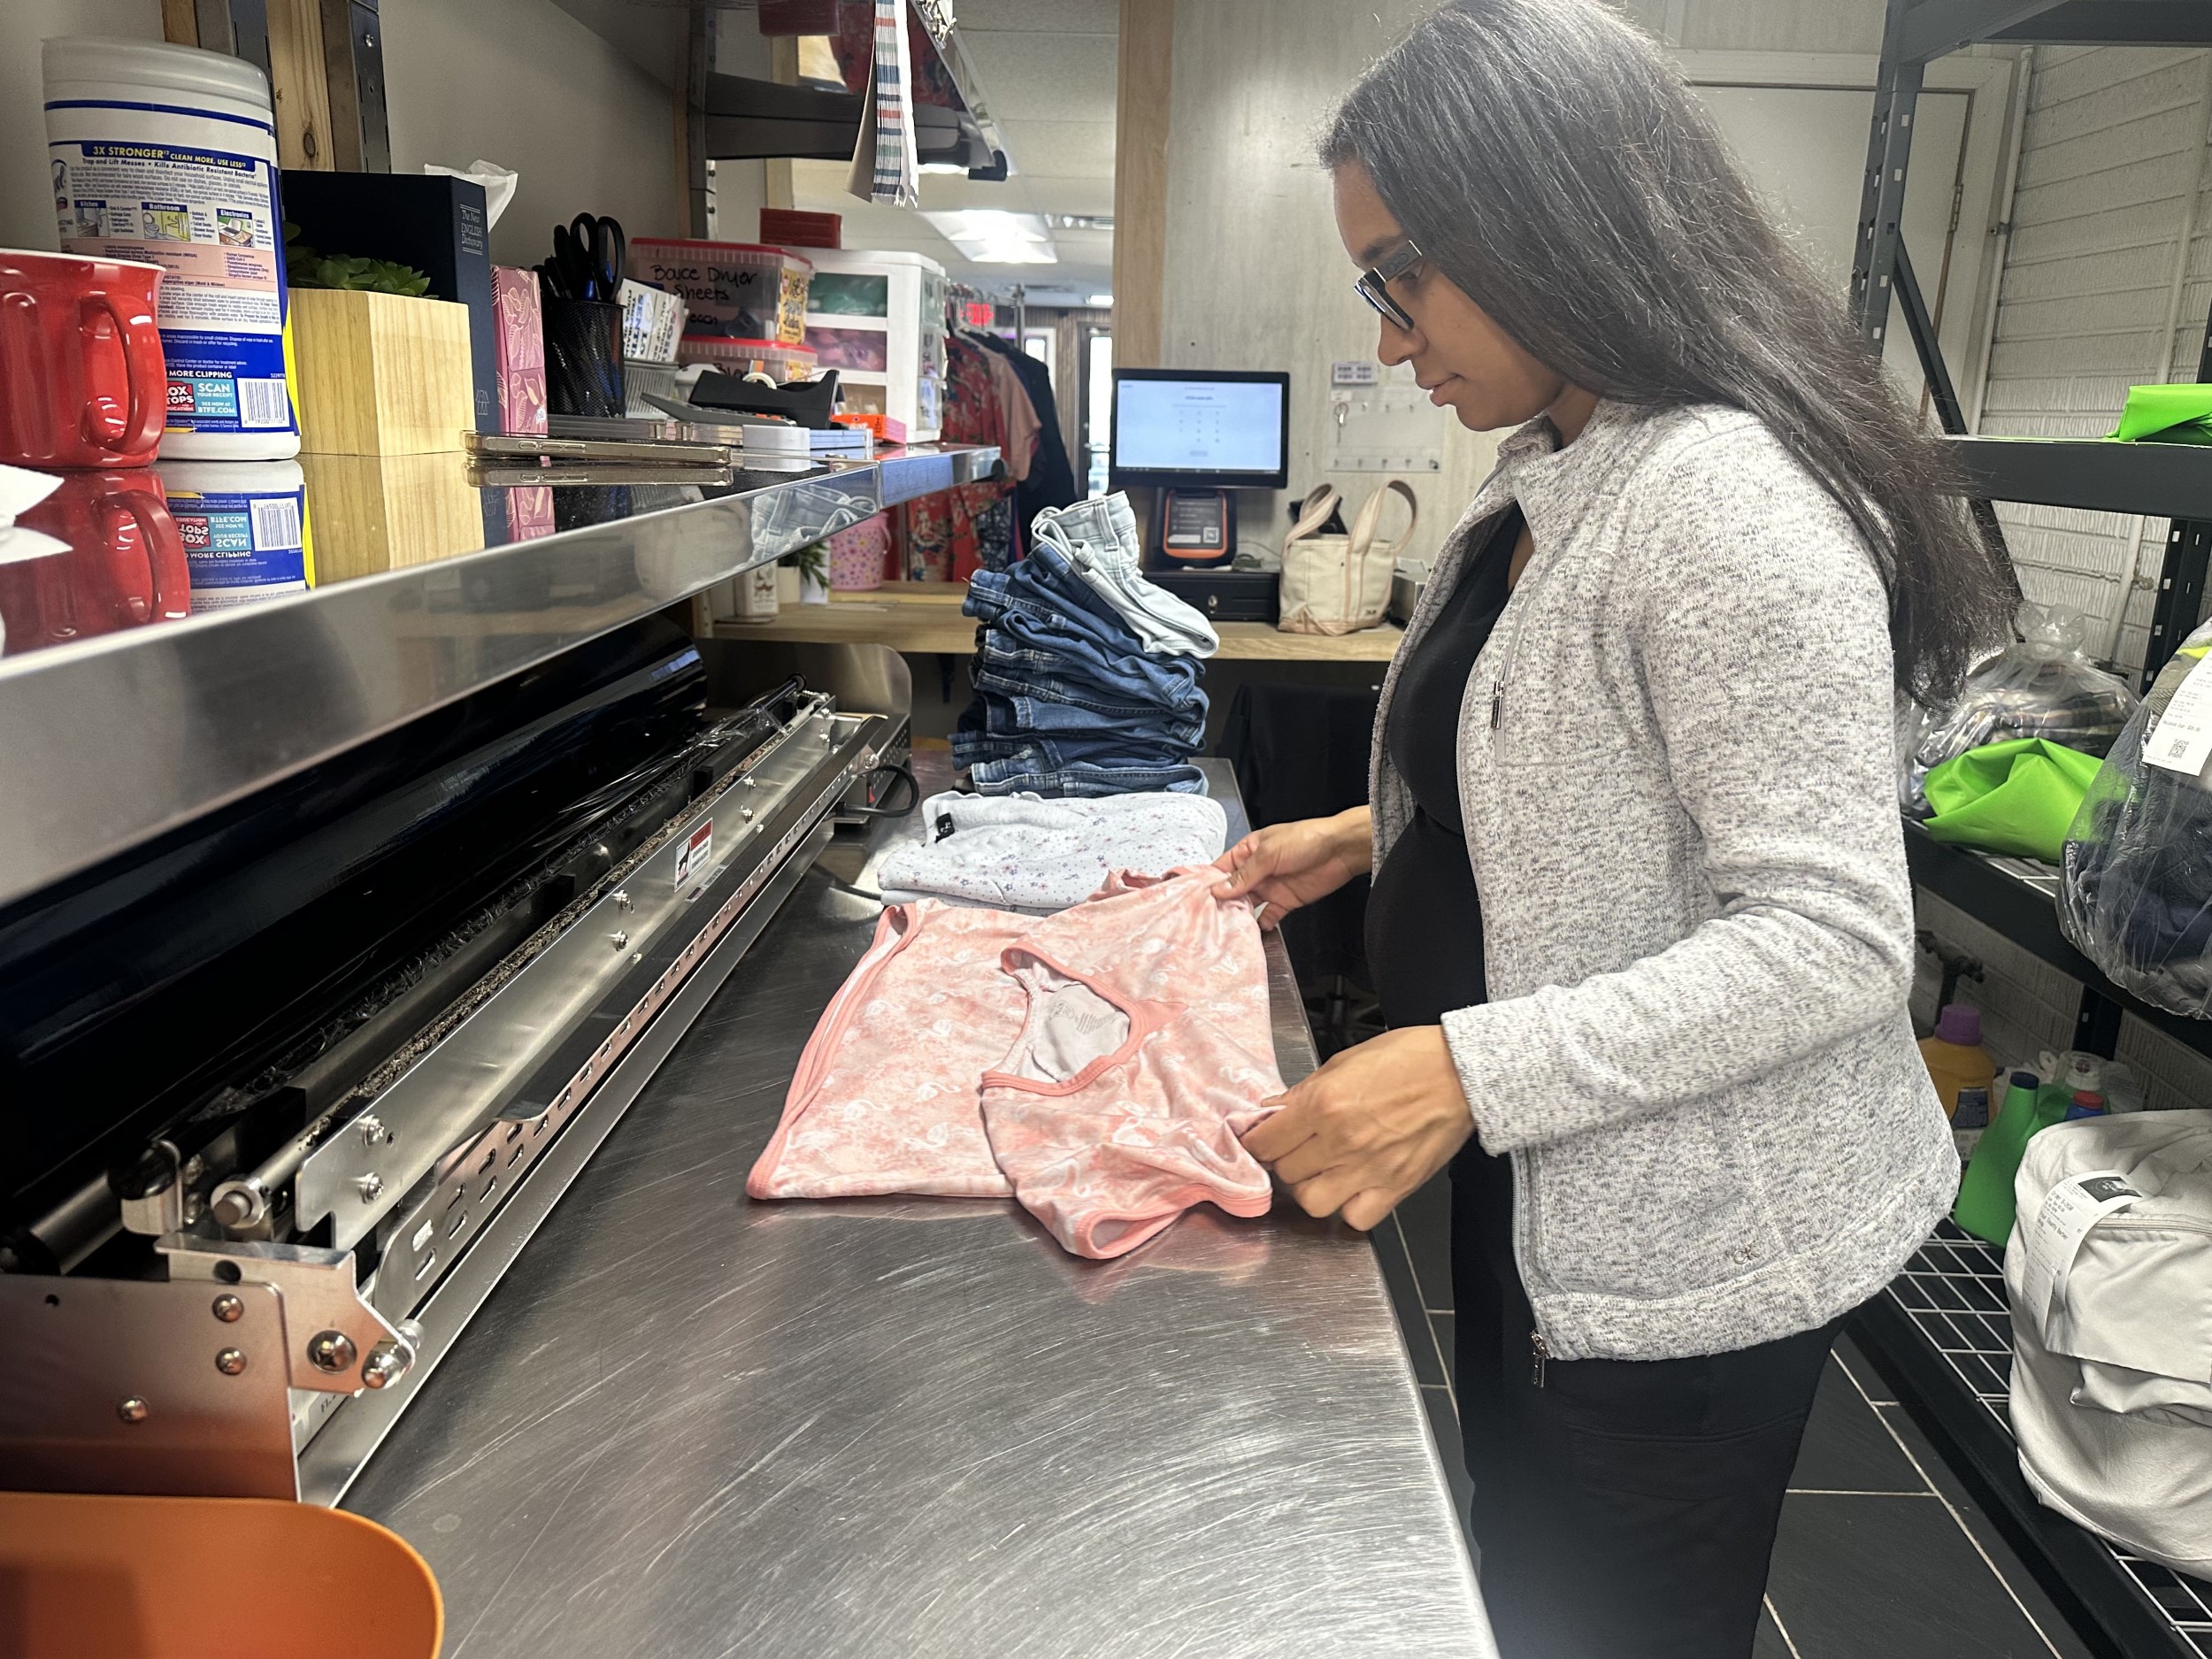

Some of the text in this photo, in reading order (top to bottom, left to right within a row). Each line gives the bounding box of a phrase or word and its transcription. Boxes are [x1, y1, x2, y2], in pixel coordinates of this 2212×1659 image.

[93, 146, 105, 155] 3X
[170, 153, 193, 162] CLEAN
[195, 155, 216, 165] MORE,
[172, 163, 205, 173] Antibiotic
[206, 165, 233, 176] Resistant
[220, 209, 250, 219] Electronics
[674, 284, 729, 300] Sheets
[167, 386, 188, 396] OX
[198, 382, 230, 393] SCAN
